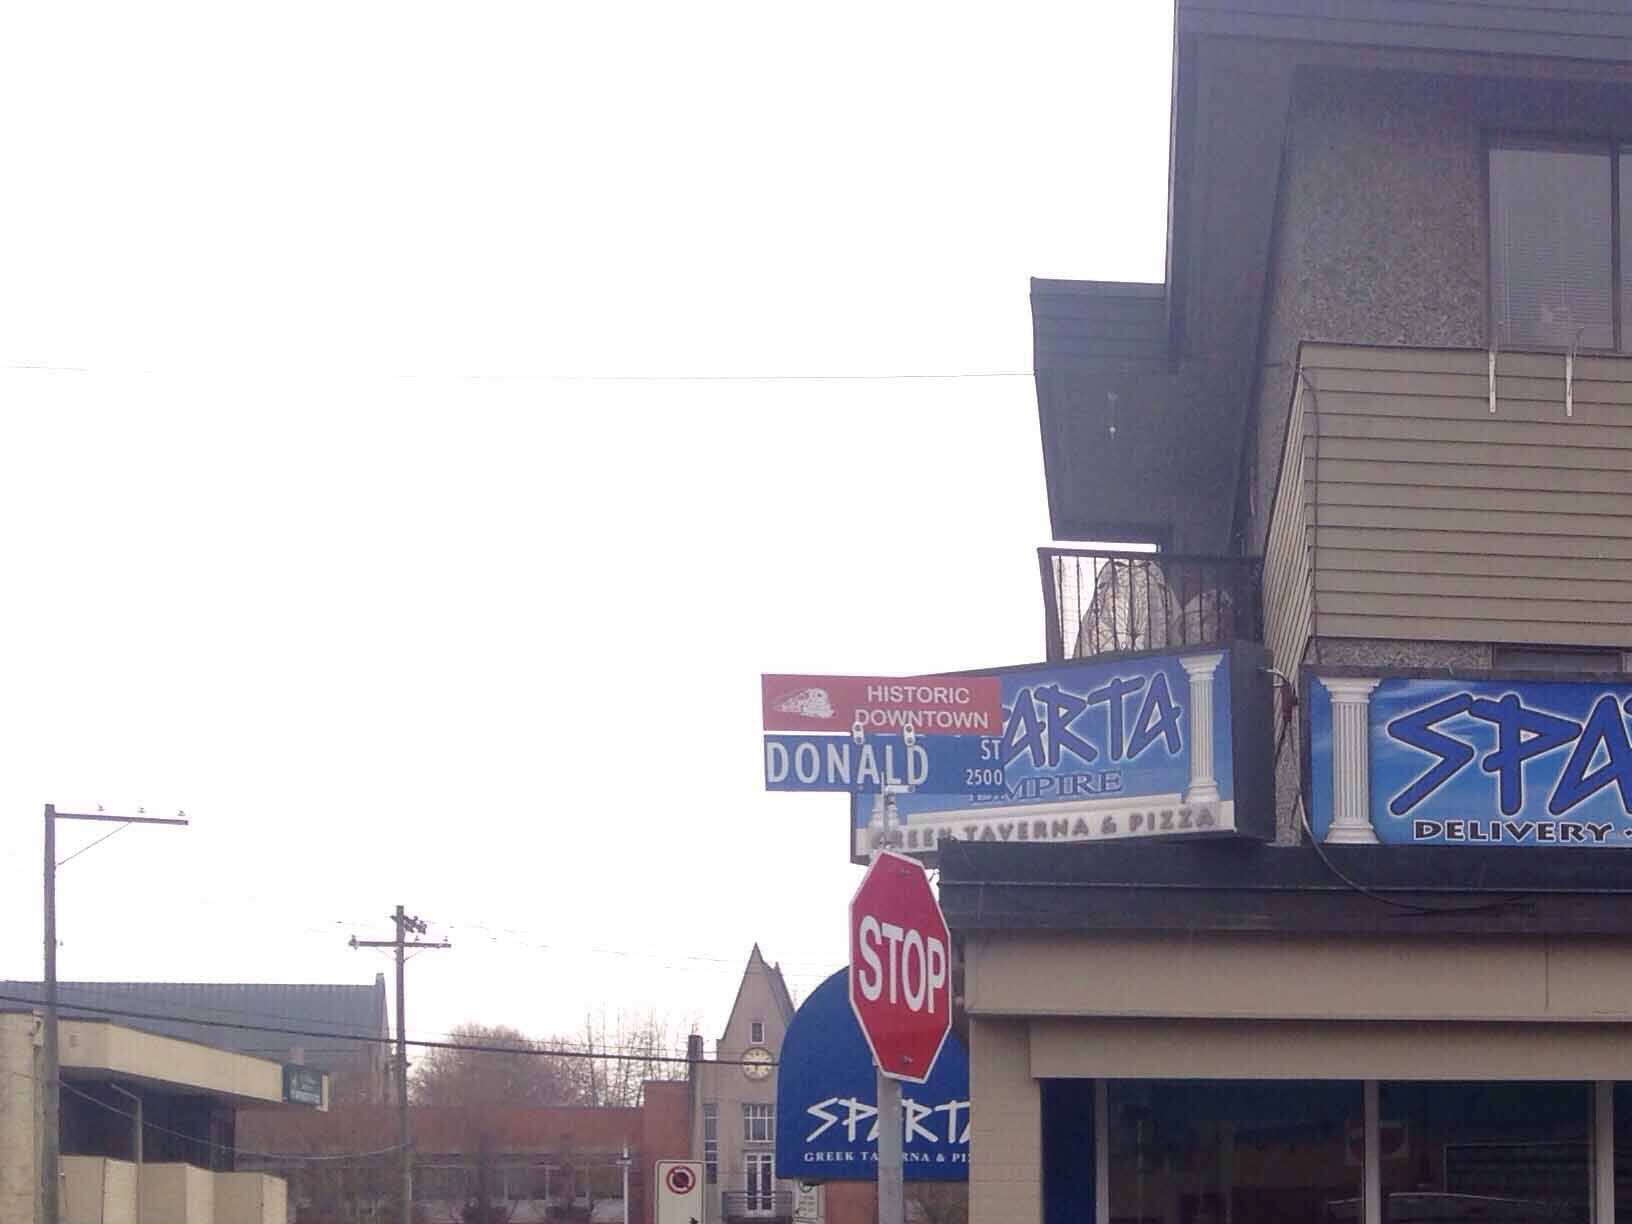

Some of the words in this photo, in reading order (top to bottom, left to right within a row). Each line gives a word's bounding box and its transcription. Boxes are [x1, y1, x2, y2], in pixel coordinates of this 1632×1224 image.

[867, 685, 970, 704] HISTORIC
[855, 708, 989, 729] DOWNTOWN
[1001, 673, 1183, 768] ARTA
[766, 741, 929, 786] DONALD
[981, 739, 1001, 761] ST
[965, 768, 1003, 785] 2500
[972, 770, 1122, 804] MPIRE
[965, 816, 1089, 841] TAVERNA
[1129, 808, 1215, 832] PIZZA
[1414, 820, 1614, 843] DELIVERY
[858, 914, 946, 1014] STOP
[806, 1097, 970, 1144] SPRT
[804, 1151, 854, 1162] GREEK
[862, 1151, 930, 1163] TARNA
